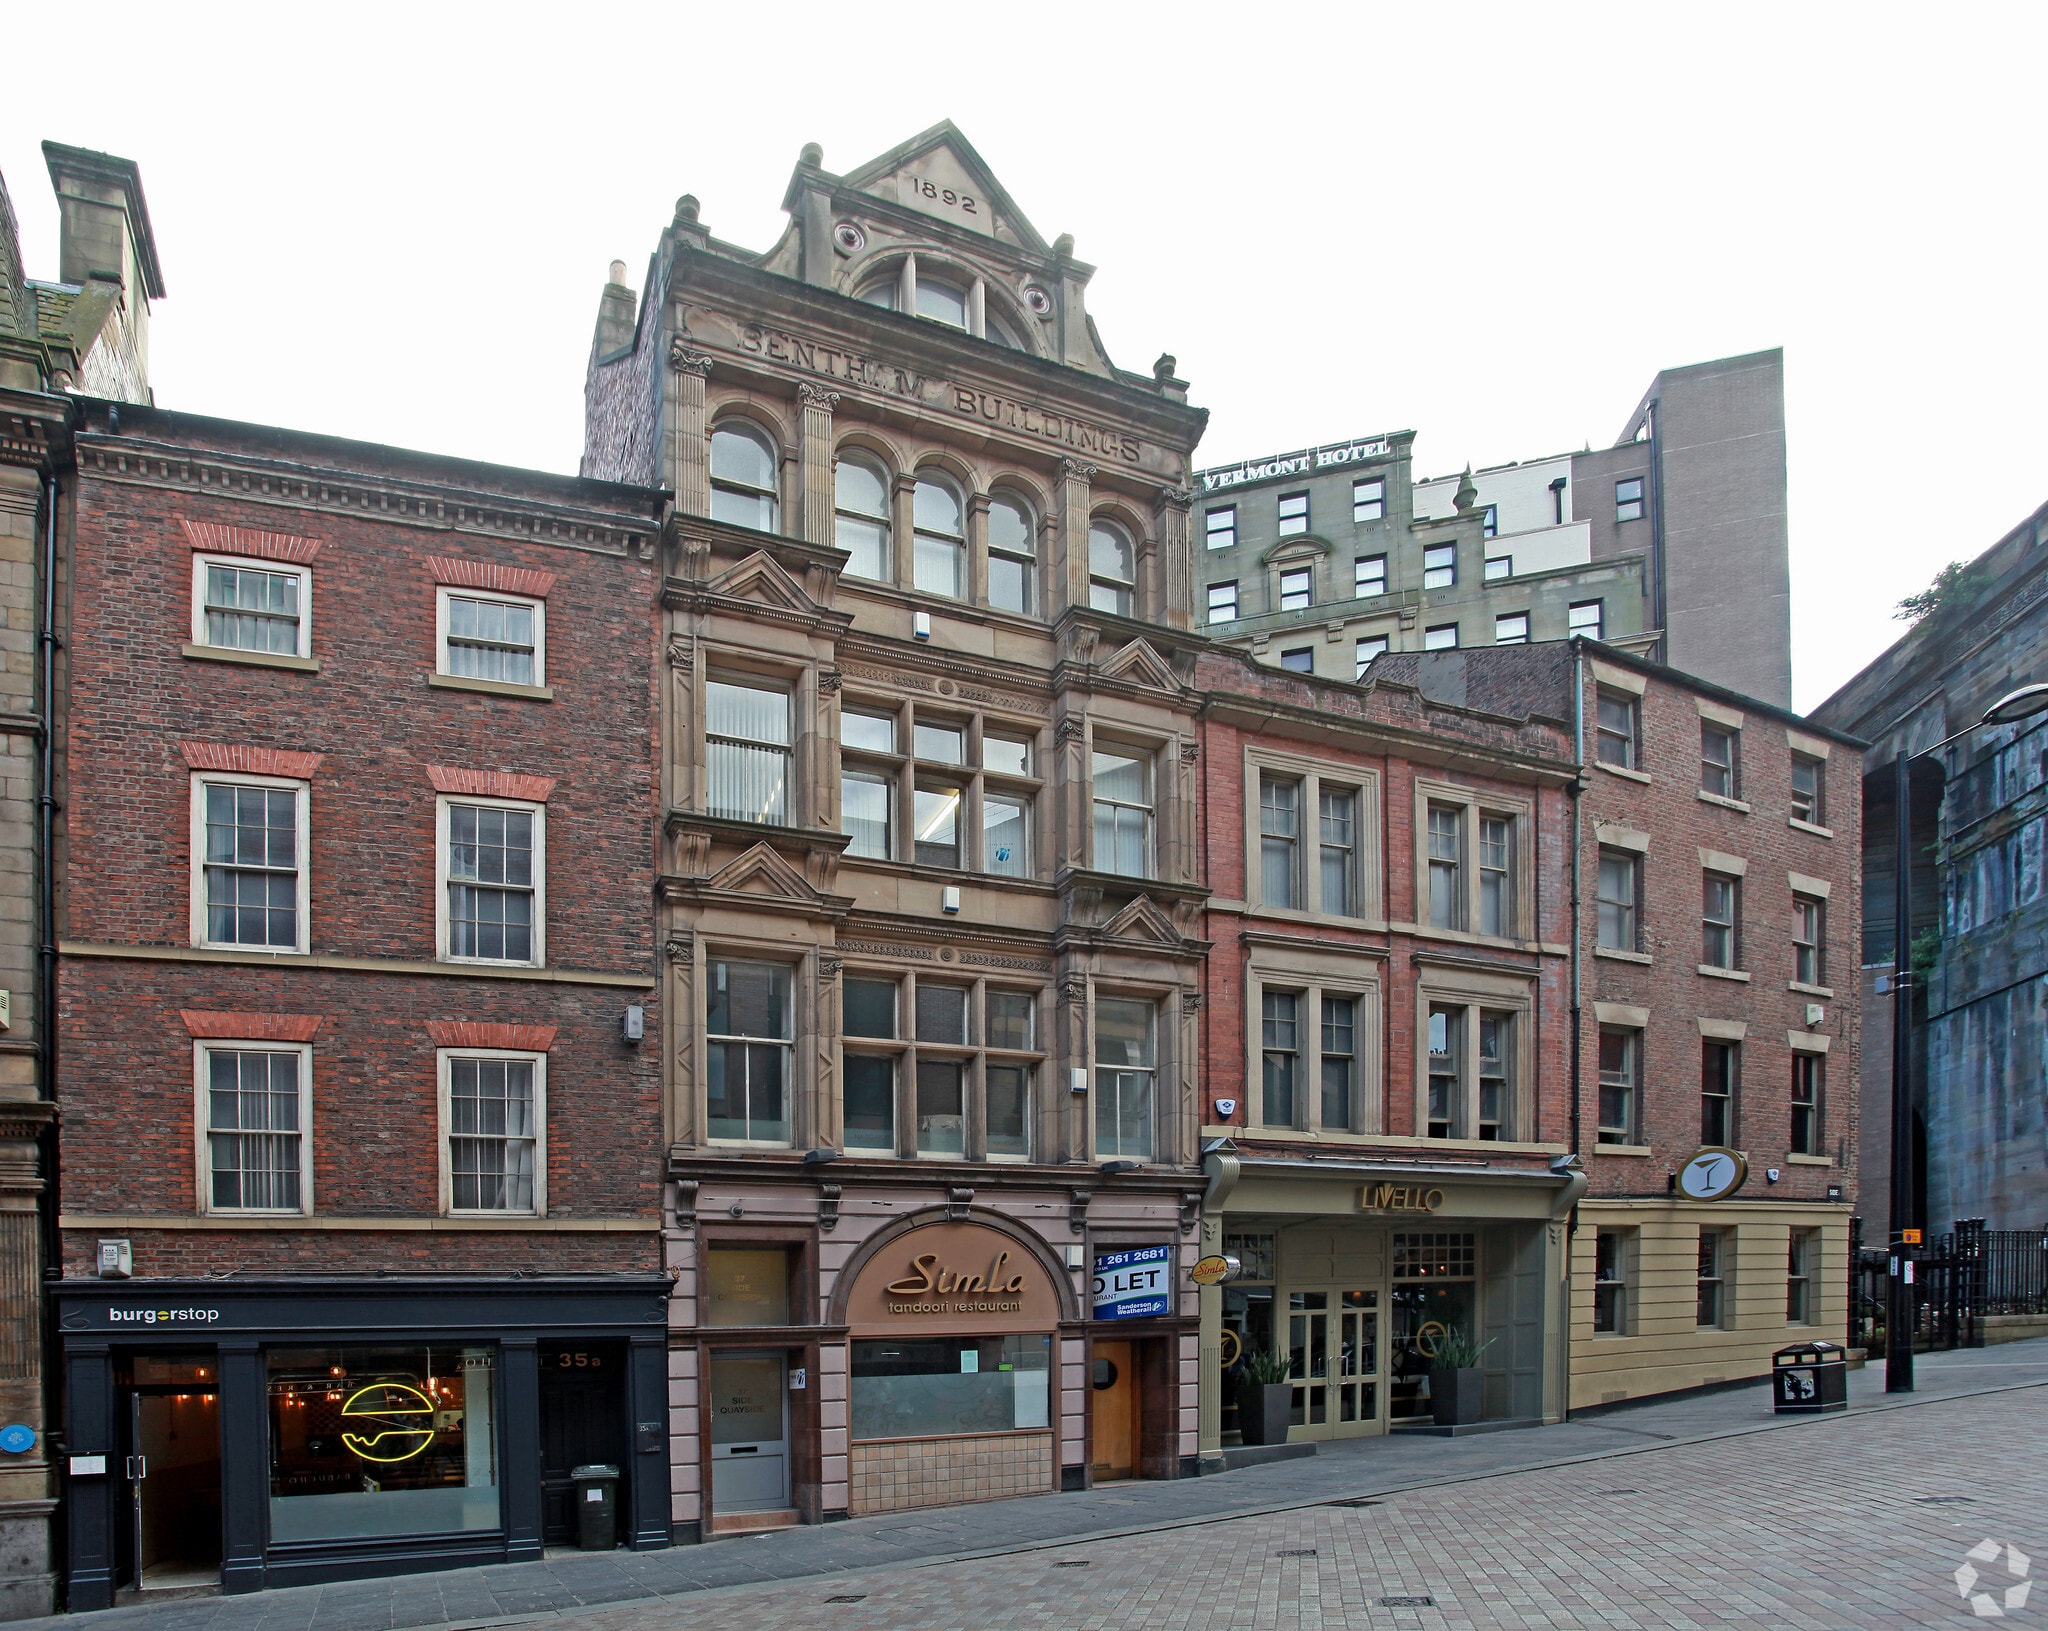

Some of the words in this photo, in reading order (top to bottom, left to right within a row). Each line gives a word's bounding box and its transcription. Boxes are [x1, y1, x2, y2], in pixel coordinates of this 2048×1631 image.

[913, 178, 977, 215] 1892
[953, 386, 1141, 464] BUILDINGS
[1202, 455, 1310, 491] VERMONT
[1316, 437, 1391, 467] HOTEL
[1362, 1183, 1445, 1212] LIVELLO
[1107, 1254, 1129, 1265] 261
[1133, 1248, 1164, 1261] 2681
[1114, 1269, 1160, 1292] LET
[888, 1300, 949, 1313] tandoori
[953, 1300, 1022, 1312] restaurant
[1117, 1302, 1152, 1311] Sanderson
[1117, 1306, 1152, 1316] Weatherall
[559, 1352, 601, 1367] 35a
[732, 1396, 753, 1404] SIDE
[720, 1406, 765, 1414] QUAYSIDE
